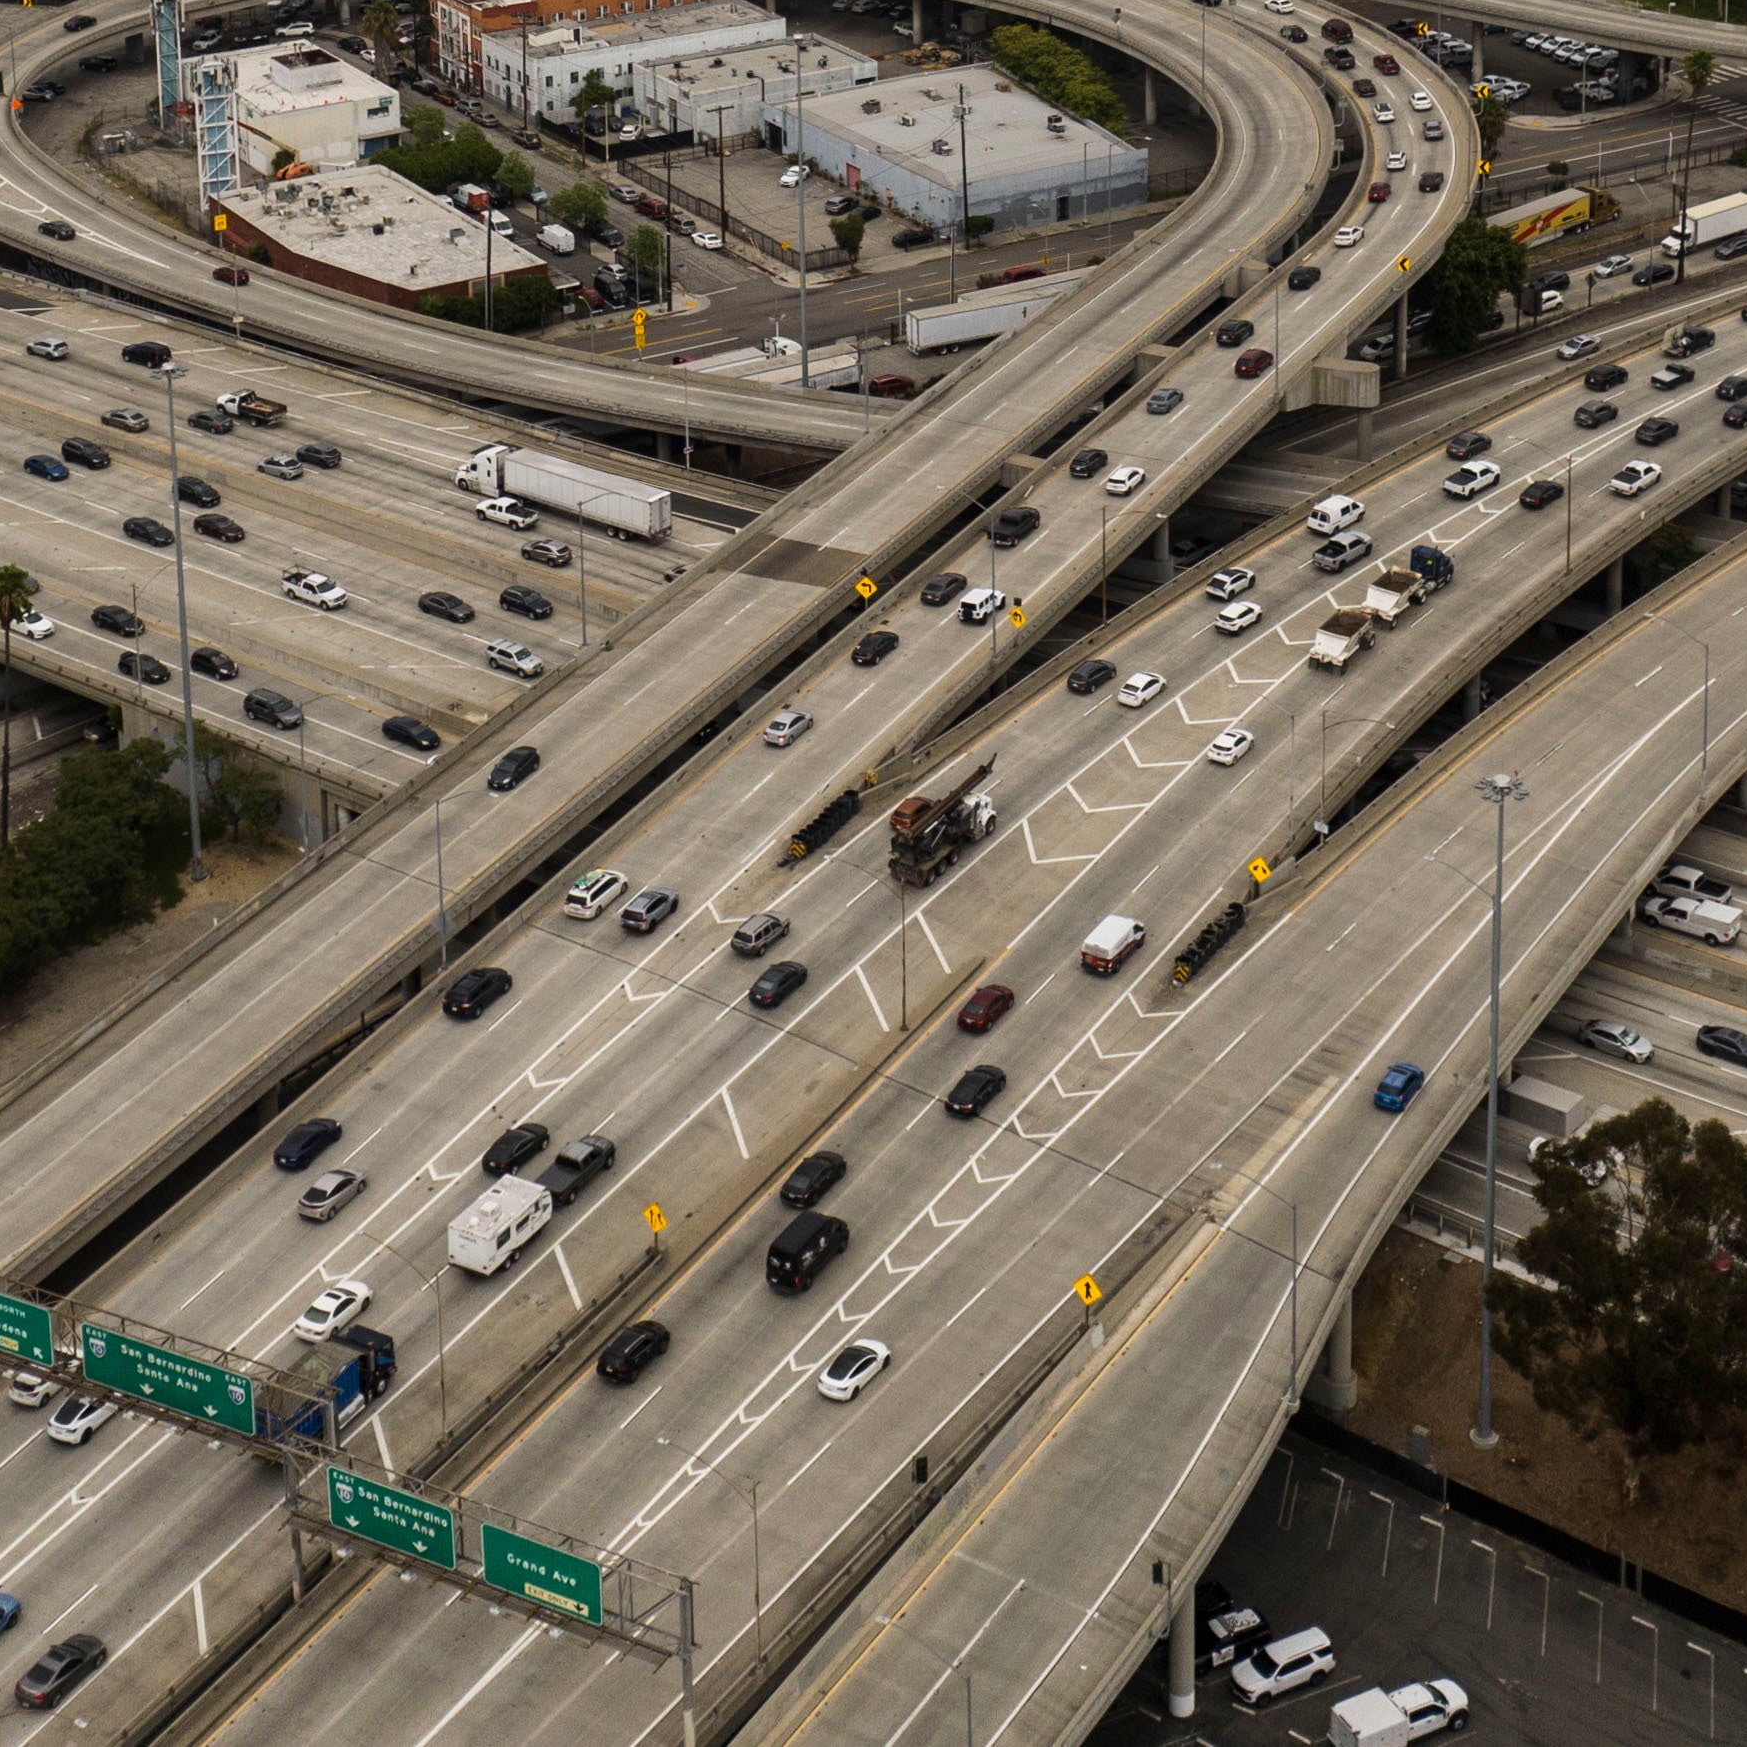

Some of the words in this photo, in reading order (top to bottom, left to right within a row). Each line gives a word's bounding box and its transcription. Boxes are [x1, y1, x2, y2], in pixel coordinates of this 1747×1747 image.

[85, 1327, 107, 1339] EAST
[121, 1344, 142, 1360] San
[147, 1352, 212, 1383] Bernardino
[136, 1363, 170, 1383] Santa
[177, 1378, 199, 1394] Ana
[225, 1374, 246, 1387] EAST
[333, 1471, 354, 1485] EAST
[358, 1486, 380, 1502] San
[384, 1496, 448, 1528] Bernardino
[373, 1506, 406, 1527] Santa
[412, 1521, 435, 1538] Ana
[506, 1552, 546, 1576] Grand
[553, 1571, 577, 1587] Ave
[547, 1594, 569, 1606] ONLY
